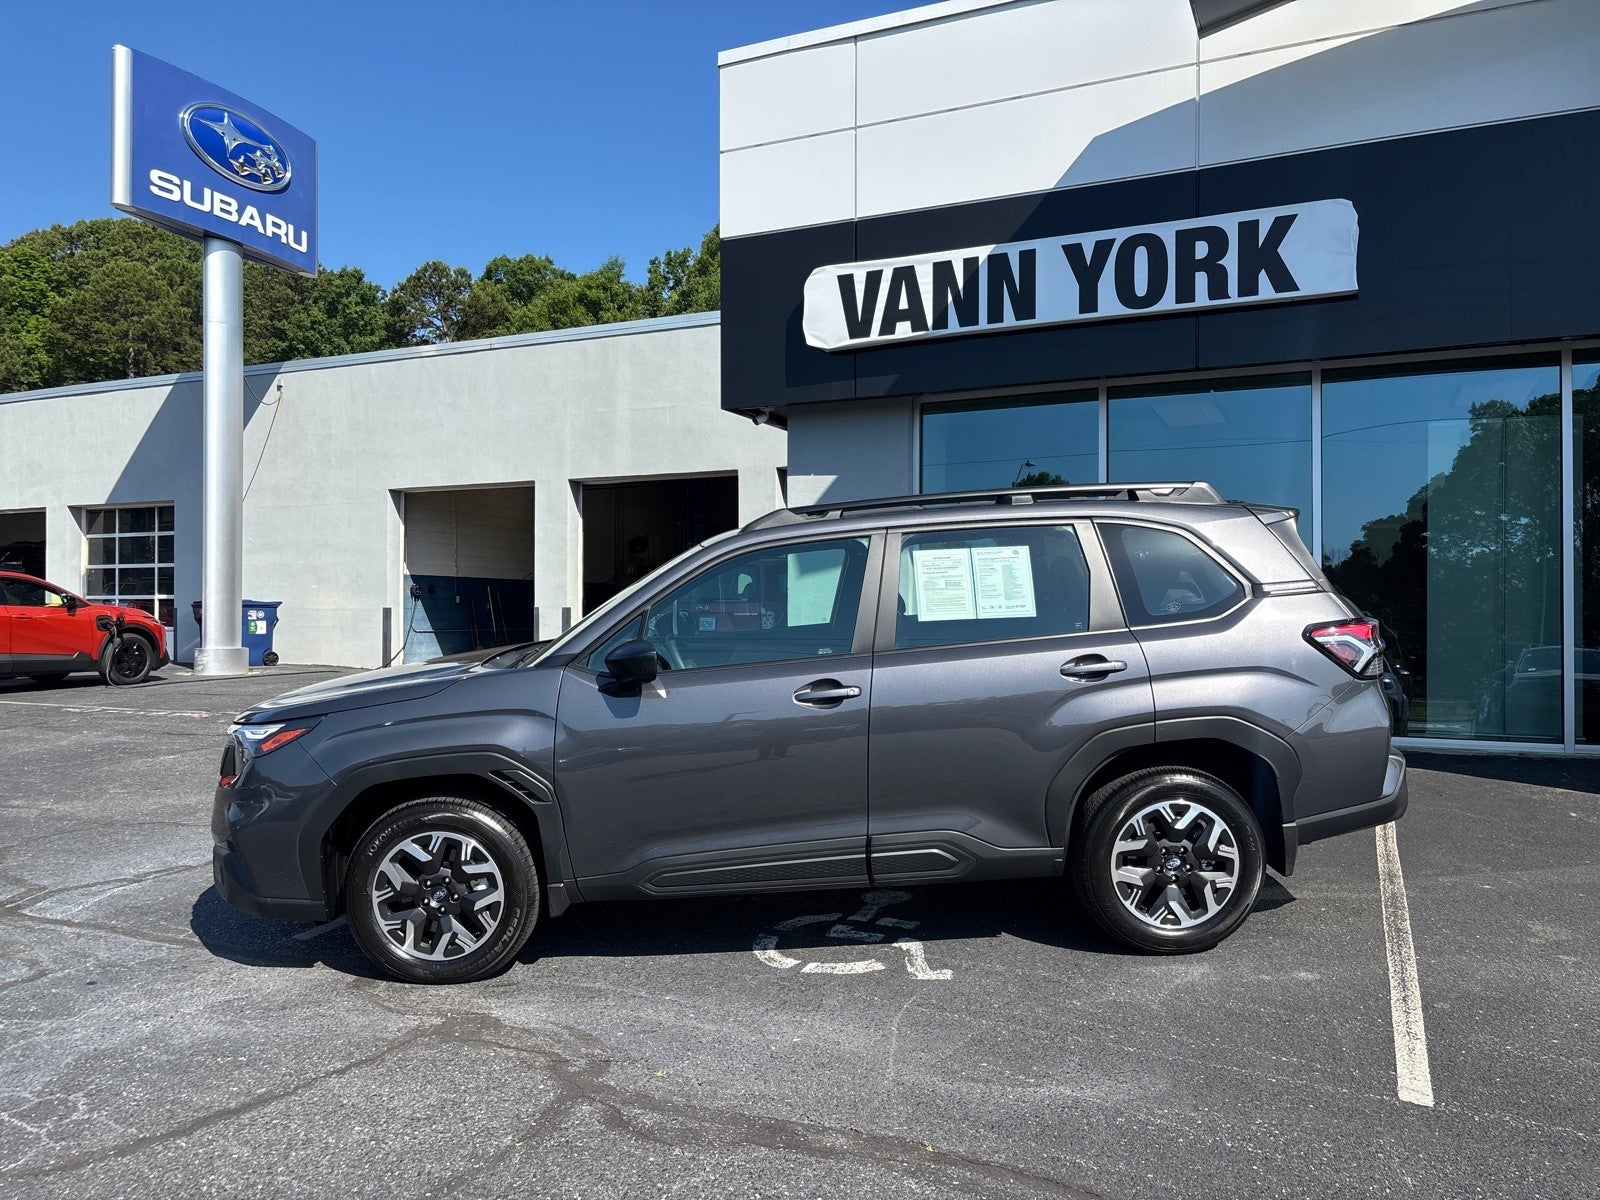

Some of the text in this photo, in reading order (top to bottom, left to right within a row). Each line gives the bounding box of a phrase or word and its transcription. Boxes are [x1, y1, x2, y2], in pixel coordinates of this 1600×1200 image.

[149, 169, 308, 254] SUBARU
[837, 213, 1301, 340] VANN YORK
